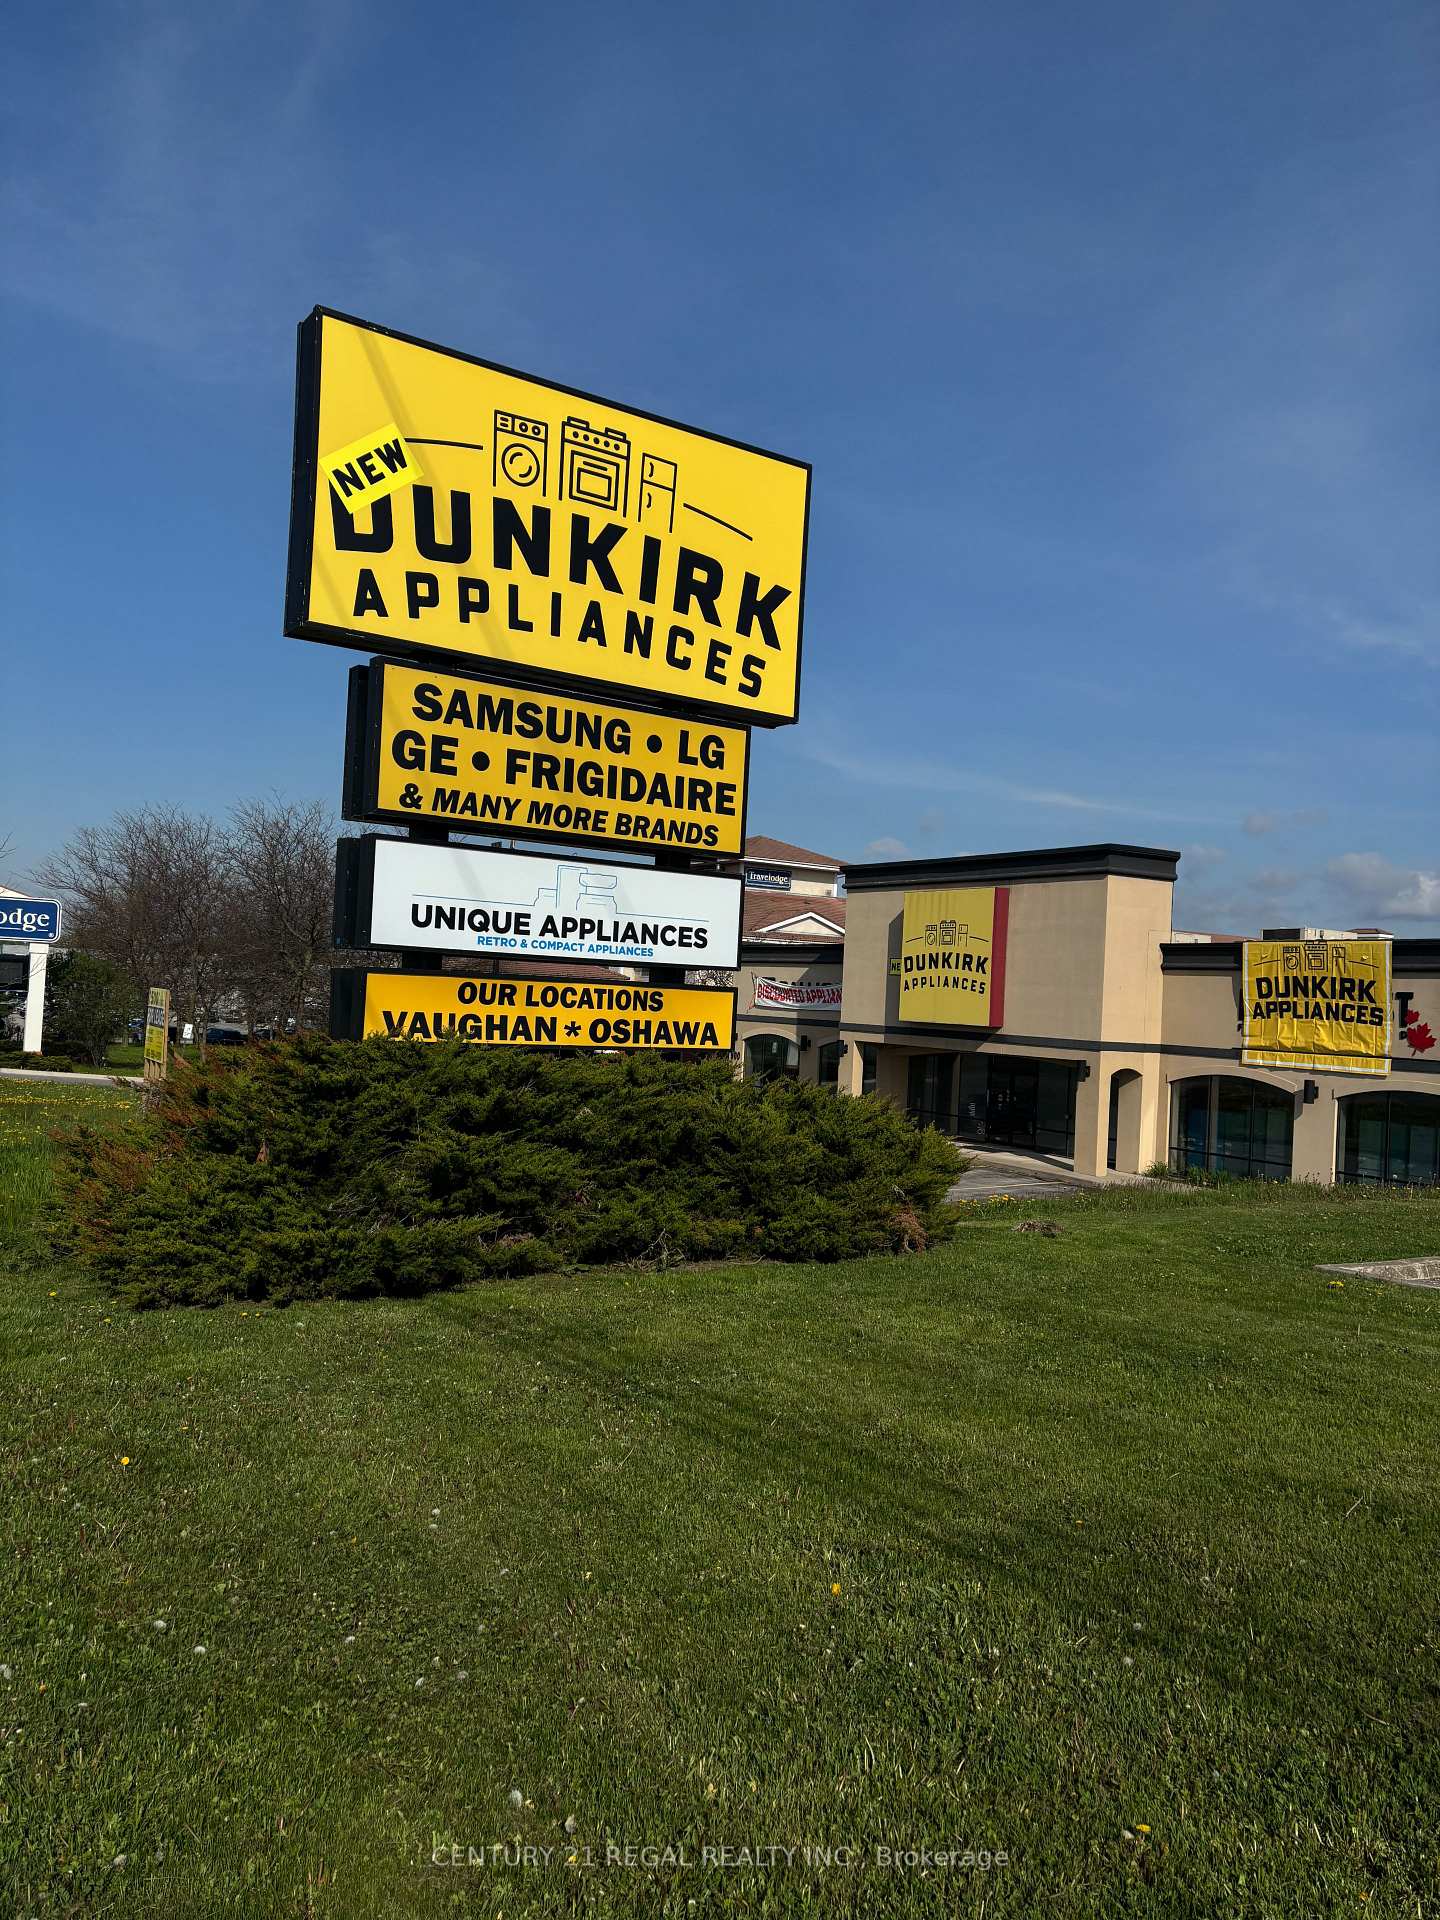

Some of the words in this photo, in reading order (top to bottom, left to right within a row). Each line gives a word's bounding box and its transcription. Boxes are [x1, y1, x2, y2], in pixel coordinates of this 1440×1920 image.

[332, 438, 408, 498] NEW
[329, 480, 792, 651] DUNKIRK
[353, 568, 766, 698] APPLIANCES
[411, 683, 631, 755] SAMSUNG
[678, 730, 725, 770] LG
[392, 730, 459, 776] GE
[505, 748, 737, 816] FRIGIDAIRE
[399, 782, 423, 809] &
[431, 787, 521, 823] MANY
[527, 800, 607, 833] MORE
[614, 813, 719, 846] BRANDS
[411, 903, 532, 936] UNIQUE
[539, 915, 708, 949] APPLIANCES
[477, 936, 518, 948] RETRO
[520, 938, 528, 948] &
[531, 939, 585, 952] COMPACT
[587, 943, 654, 957] APPLIANCES
[904, 952, 989, 974] DUNKIRK
[457, 981, 518, 1006] OUR
[525, 984, 664, 1012] LOCATIONS
[904, 976, 986, 994] APPLIANCES
[1255, 975, 1377, 1004] DUNKIRK
[382, 1010, 557, 1042] VAUGHAN
[589, 1018, 719, 1046] OSHAWA
[1252, 1001, 1384, 1027] APPLIANCES
